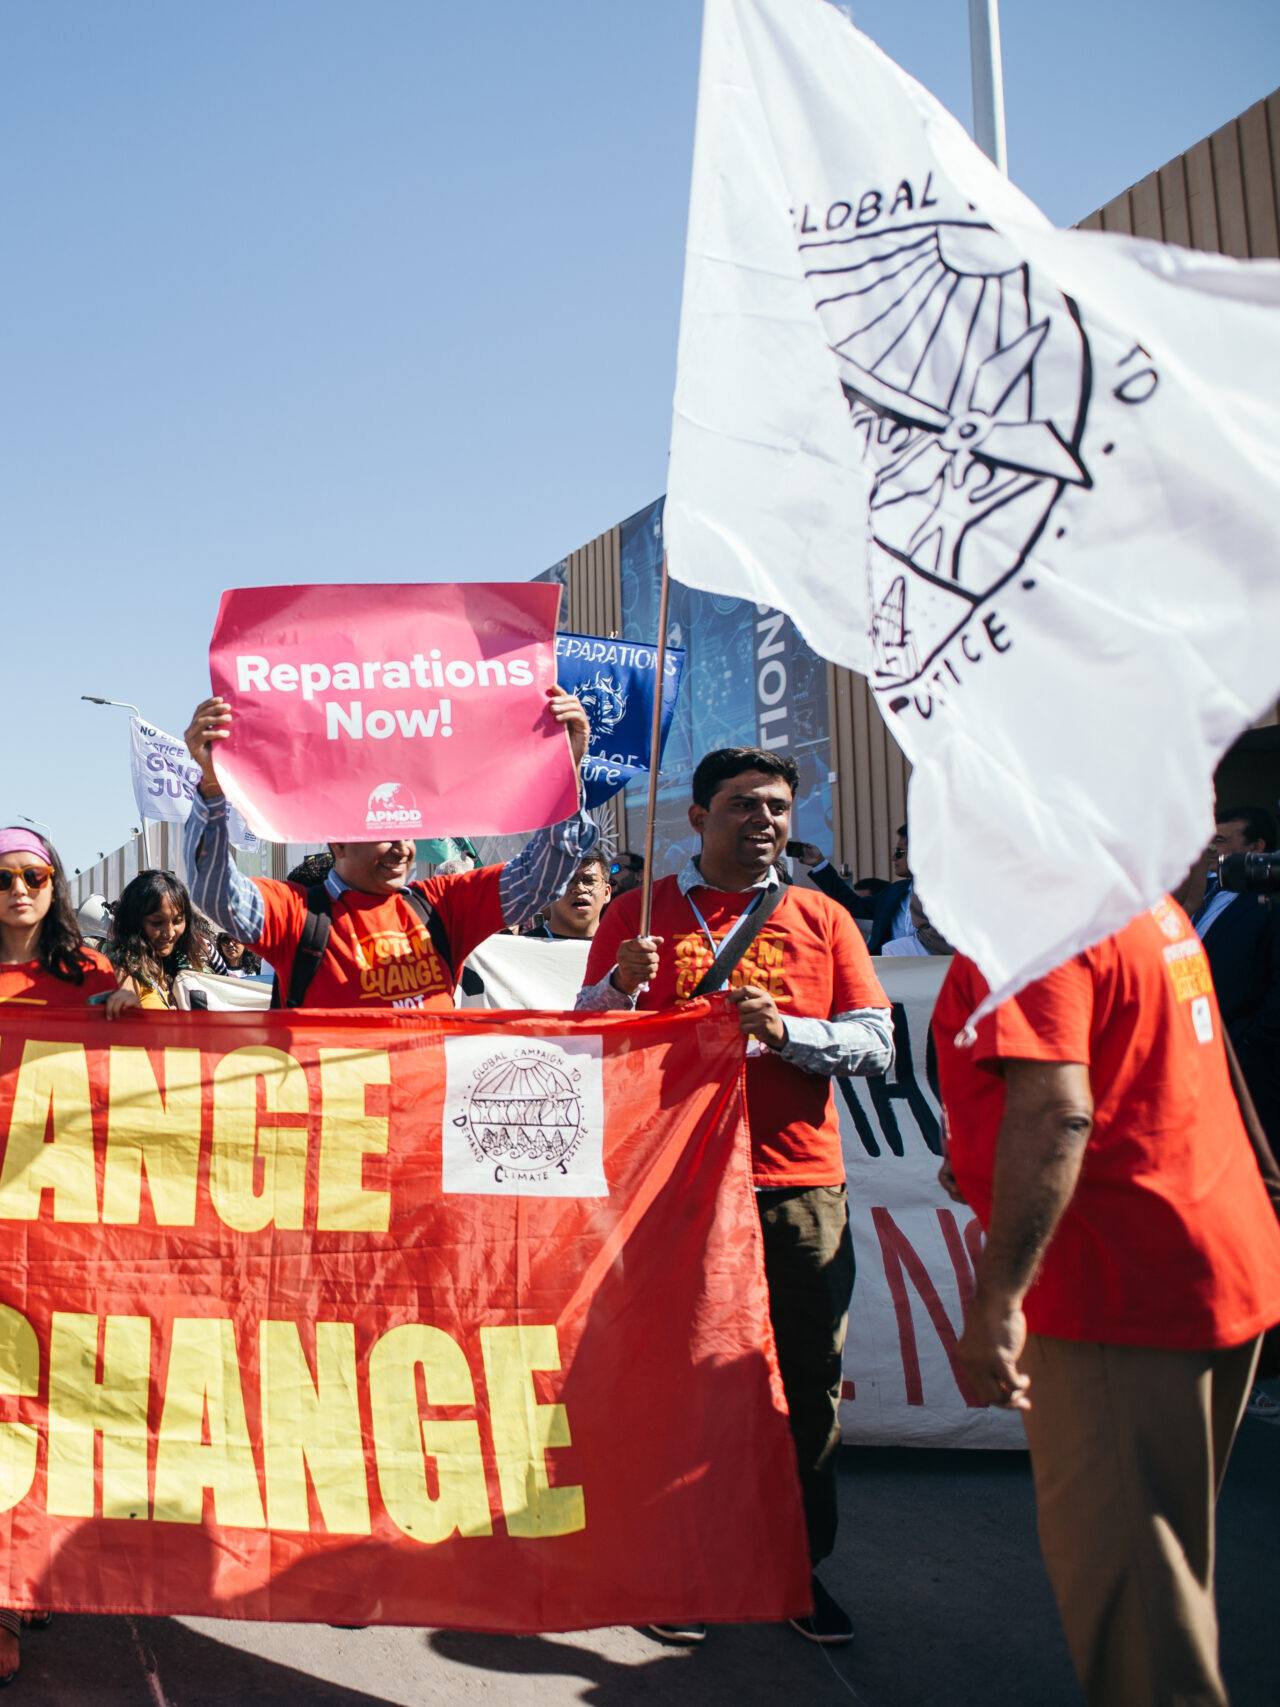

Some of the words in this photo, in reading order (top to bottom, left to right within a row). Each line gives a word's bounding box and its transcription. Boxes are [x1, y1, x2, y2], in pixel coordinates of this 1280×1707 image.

[789, 170, 939, 235] LOBAL
[235, 648, 535, 701] Reparations
[139, 725, 157, 737] NO
[325, 698, 454, 740] Now!
[365, 809, 422, 822] APMDD
[360, 955, 443, 995] CHANGE
[472, 1051, 508, 1081] GLOBAL
[513, 1048, 564, 1066] CAMPAIGN
[570, 1067, 582, 1082] TO
[494, 1165, 549, 1183] CLIMATE
